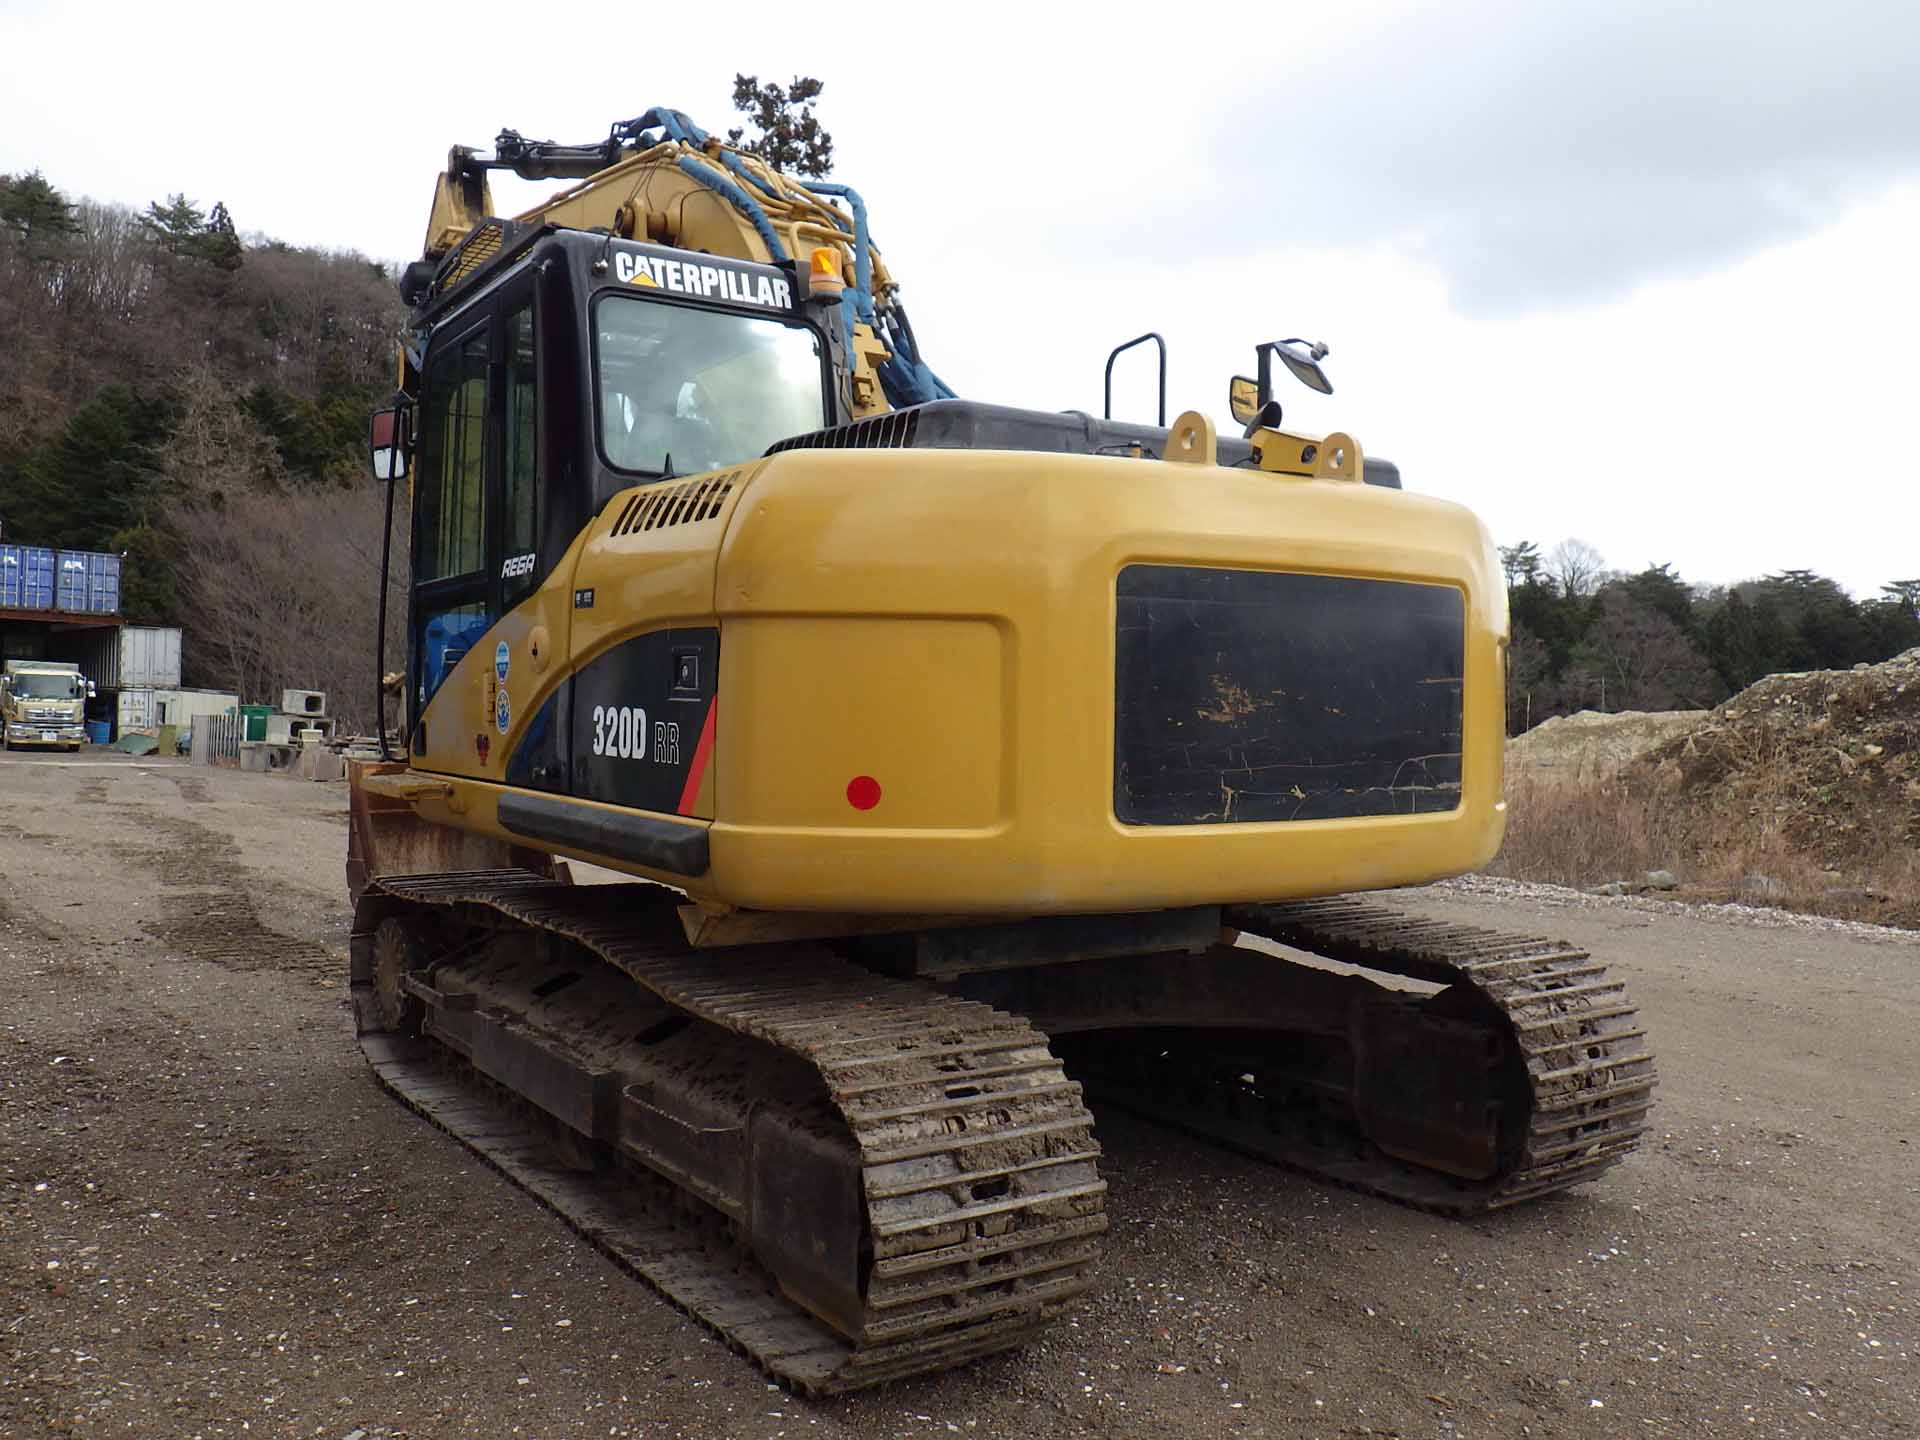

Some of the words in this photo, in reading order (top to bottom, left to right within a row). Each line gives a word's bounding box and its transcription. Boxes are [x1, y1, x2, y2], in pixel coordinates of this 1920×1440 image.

[615, 251, 793, 309] CATERPILLAR
[593, 705, 647, 760] 320D
[654, 721, 680, 765] RR
